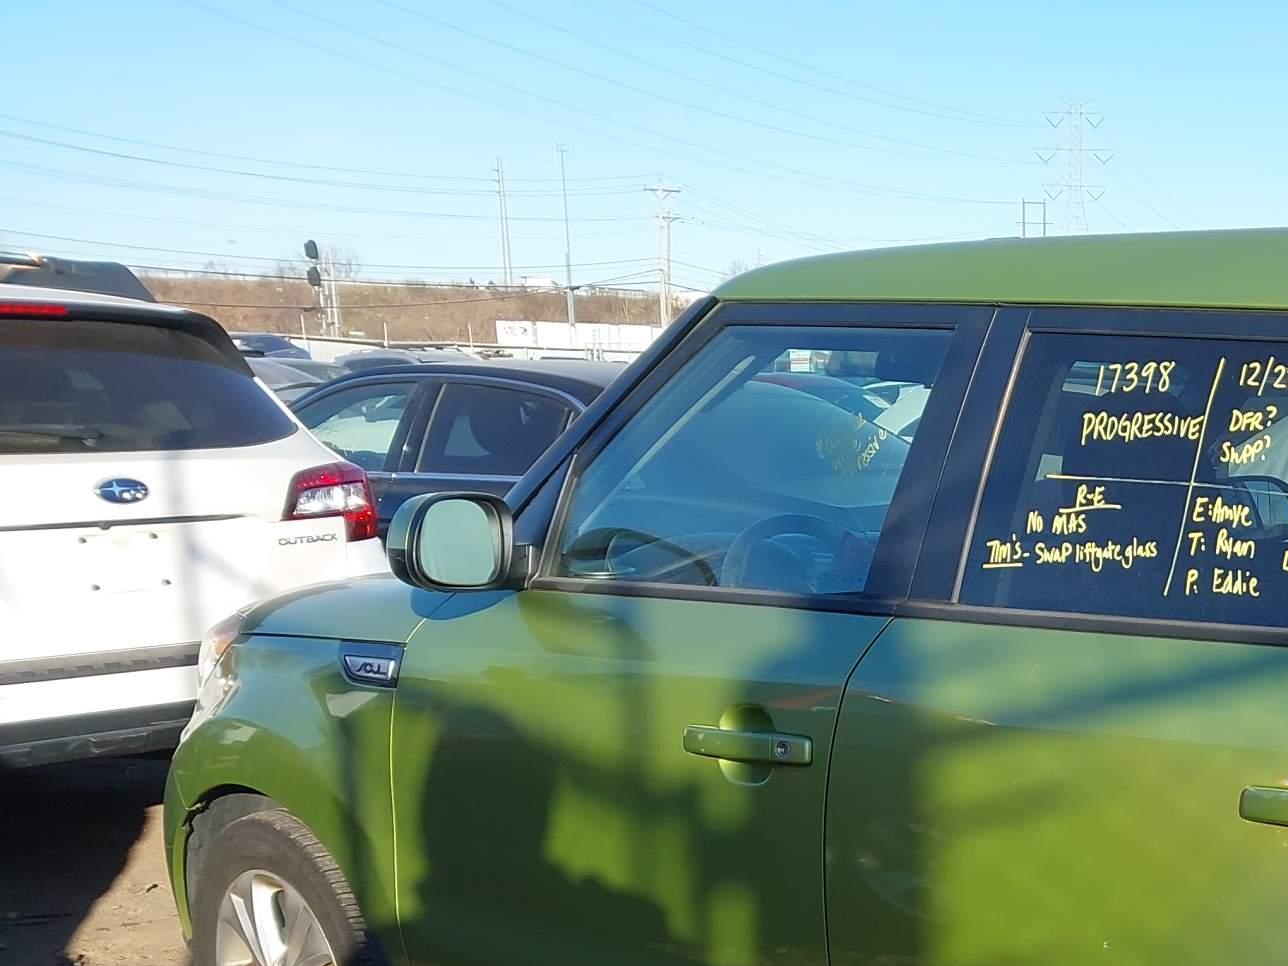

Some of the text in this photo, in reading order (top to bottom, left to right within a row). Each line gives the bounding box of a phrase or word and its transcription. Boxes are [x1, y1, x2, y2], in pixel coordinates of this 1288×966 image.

[1095, 361, 1176, 396] 17398
[1081, 411, 1204, 446] PROGRESSIVE
[1229, 405, 1277, 431] DFR?
[278, 533, 338, 546] OUTBACK
[1188, 528, 1256, 560] T: Ryan
[1212, 567, 1260, 597] Eddie
